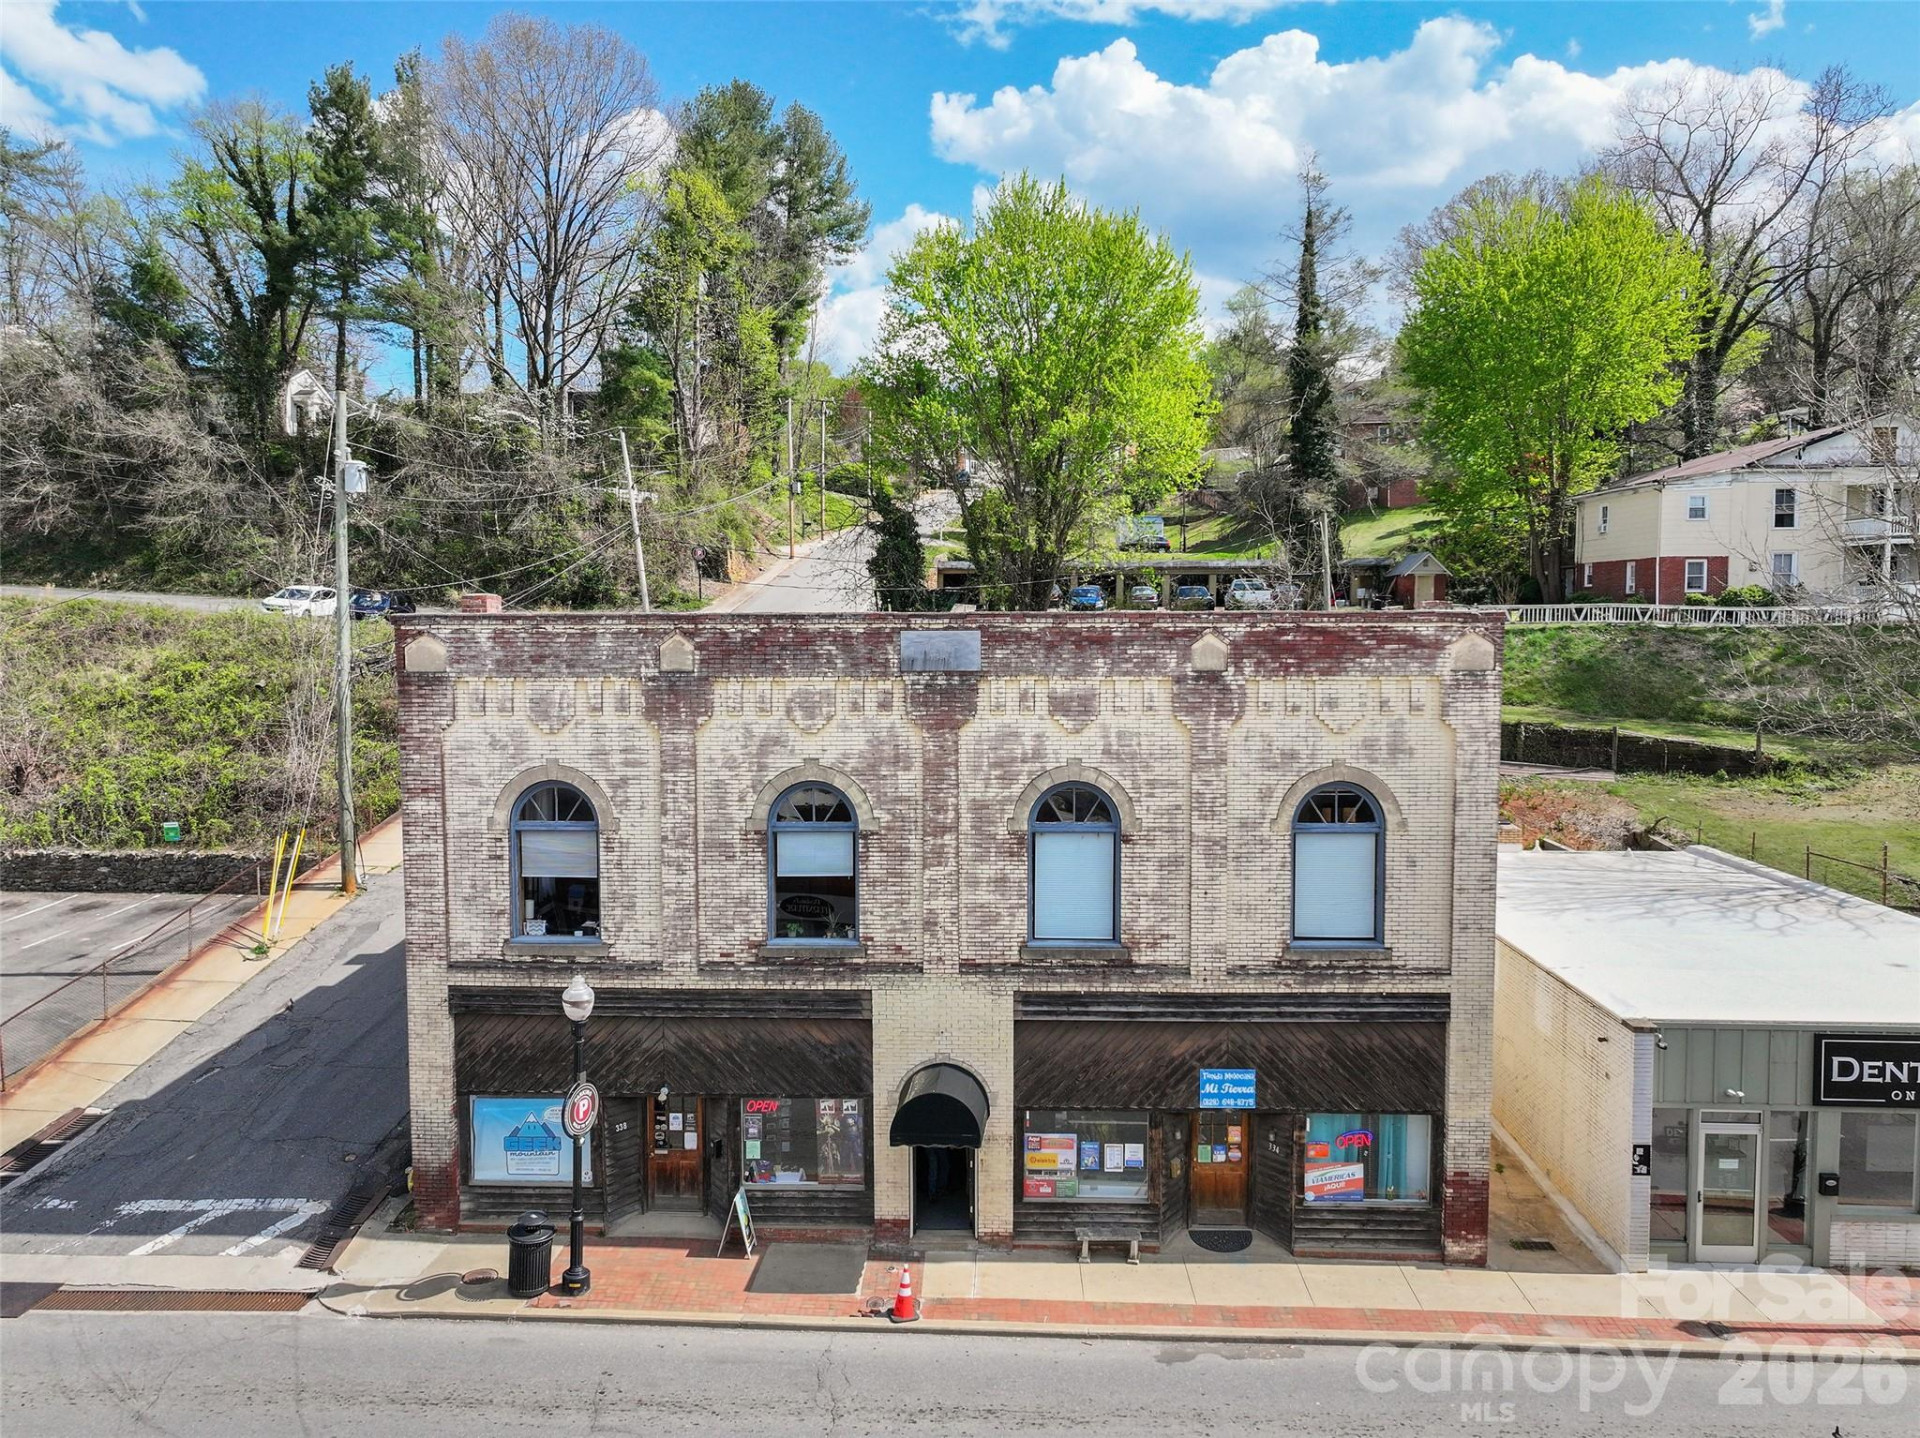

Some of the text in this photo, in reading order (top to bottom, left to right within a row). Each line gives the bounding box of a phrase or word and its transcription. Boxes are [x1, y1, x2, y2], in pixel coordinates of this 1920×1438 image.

[1201, 1083, 1255, 1093] Mi Tierra
[1891, 1090, 1916, 1101] ON
[579, 1099, 589, 1120] P
[746, 1100, 778, 1112] OPEN
[504, 1136, 561, 1151] GEEK
[1336, 1134, 1371, 1149] OPEN
[510, 1149, 556, 1157] mountain
[1268, 1142, 1280, 1154] 334
[1312, 1172, 1356, 1184] VIAMERICAS
